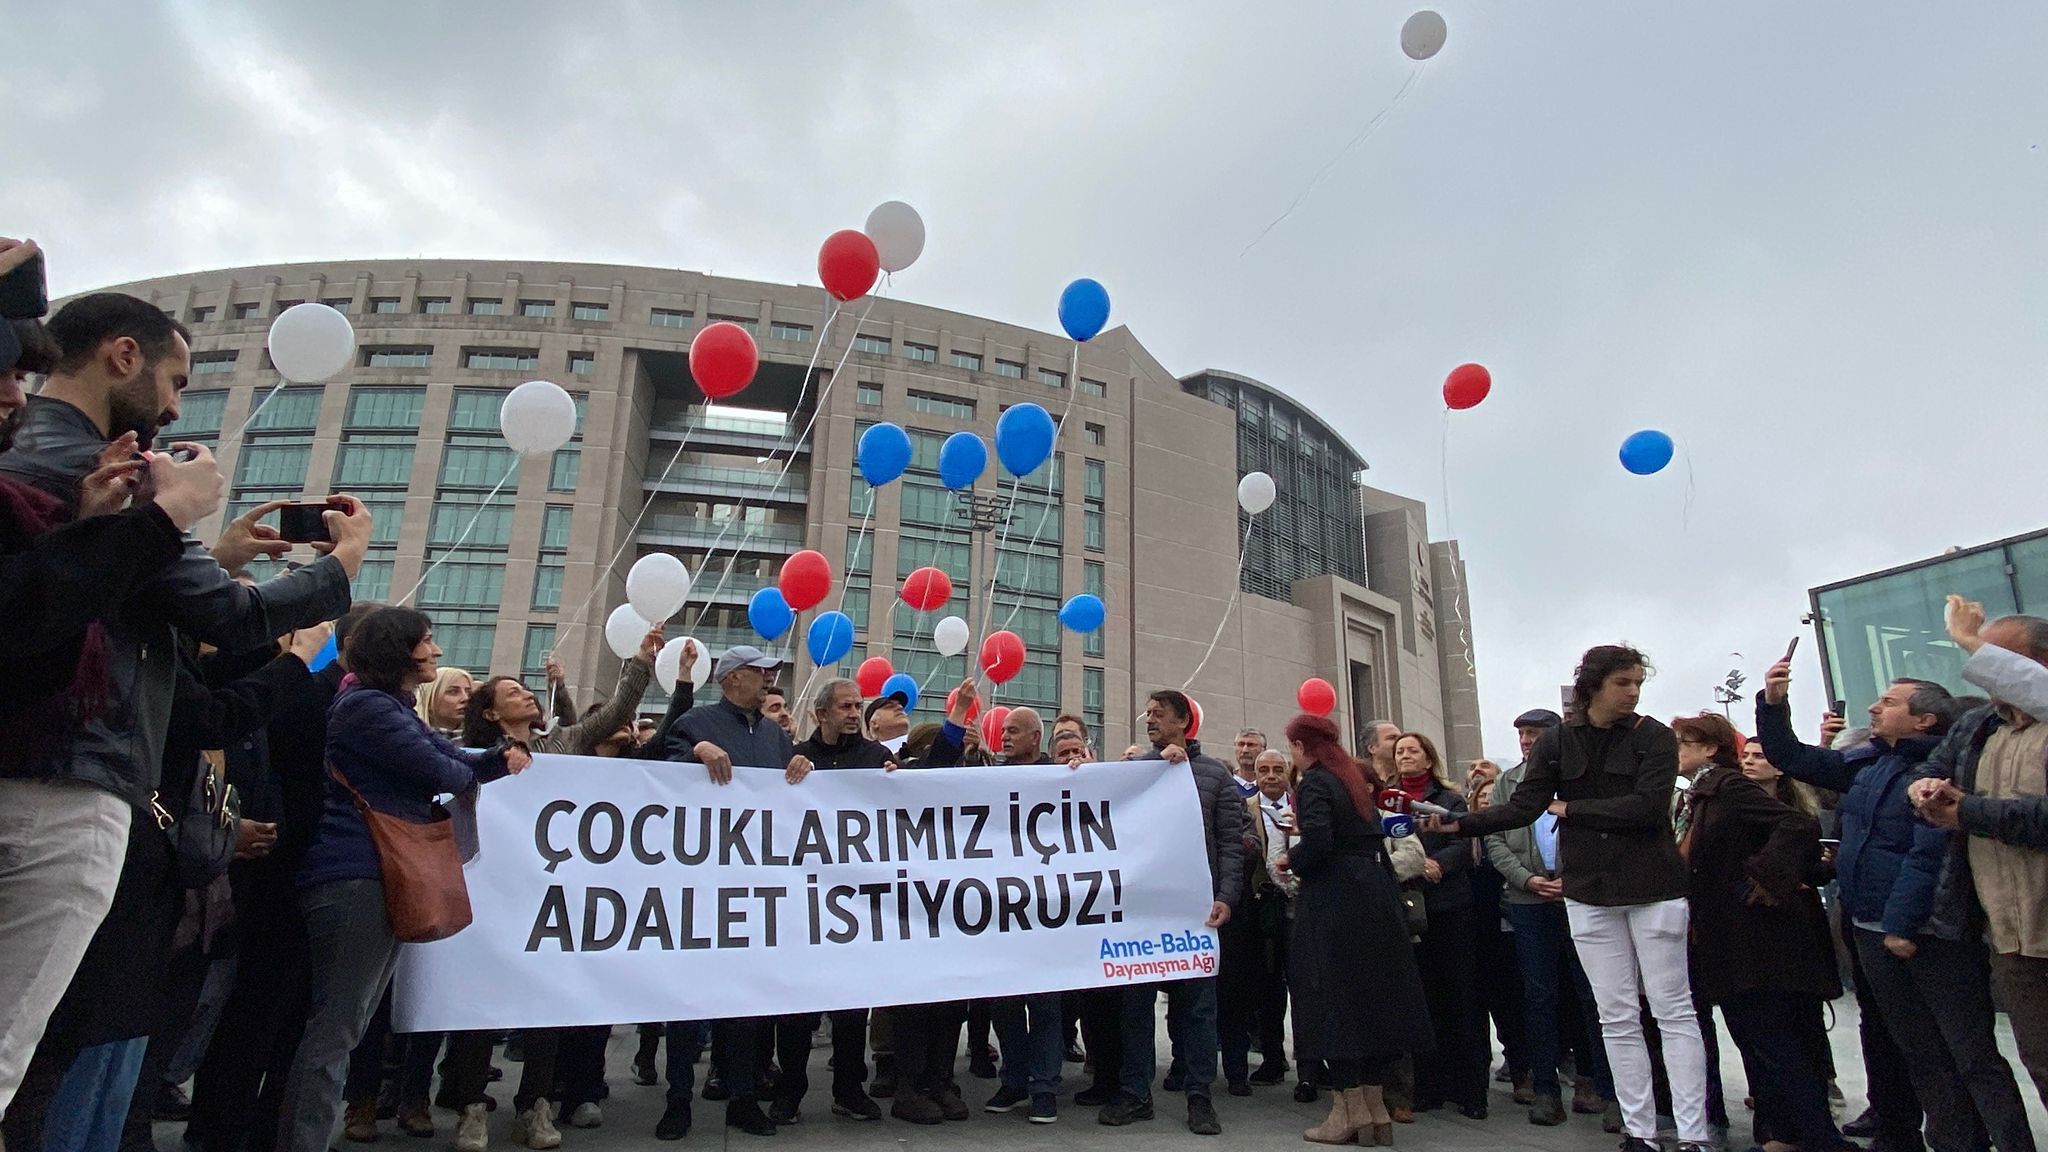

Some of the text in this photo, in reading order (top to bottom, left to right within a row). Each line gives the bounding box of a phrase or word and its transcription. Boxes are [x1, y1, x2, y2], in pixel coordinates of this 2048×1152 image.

[534, 791, 1117, 874] ÇOCUKLARIMIZ İÇİN
[524, 868, 1123, 952] ADALET İSTİYORUZ!
[1100, 929, 1215, 960] Anne-Baba
[1103, 951, 1215, 980] Dayanışma Ağı
